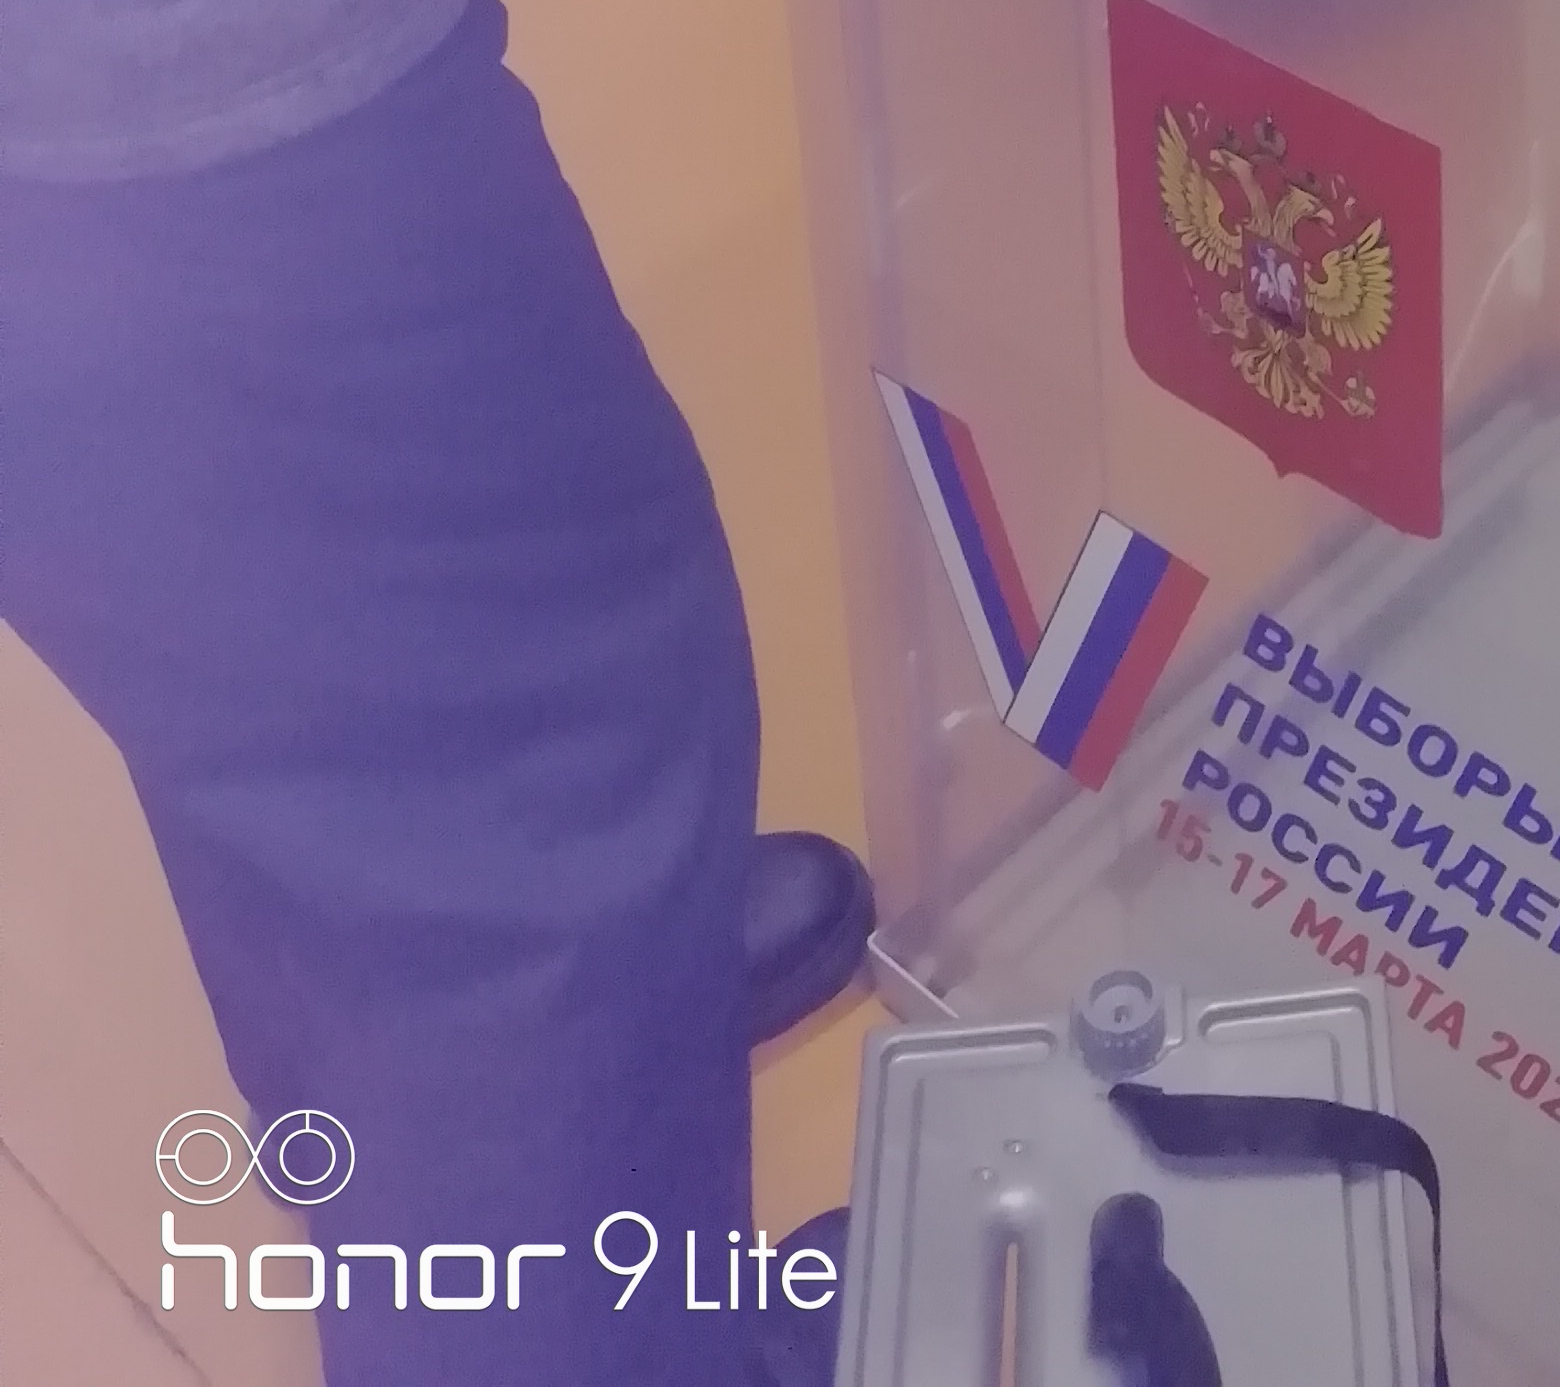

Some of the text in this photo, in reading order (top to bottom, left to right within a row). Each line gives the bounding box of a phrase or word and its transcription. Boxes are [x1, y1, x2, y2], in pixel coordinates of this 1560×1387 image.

[1155, 798, 1288, 910] 15-17
[1289, 897, 1467, 1050] МАРТА
[1181, 749, 1470, 970] РОССИИ
